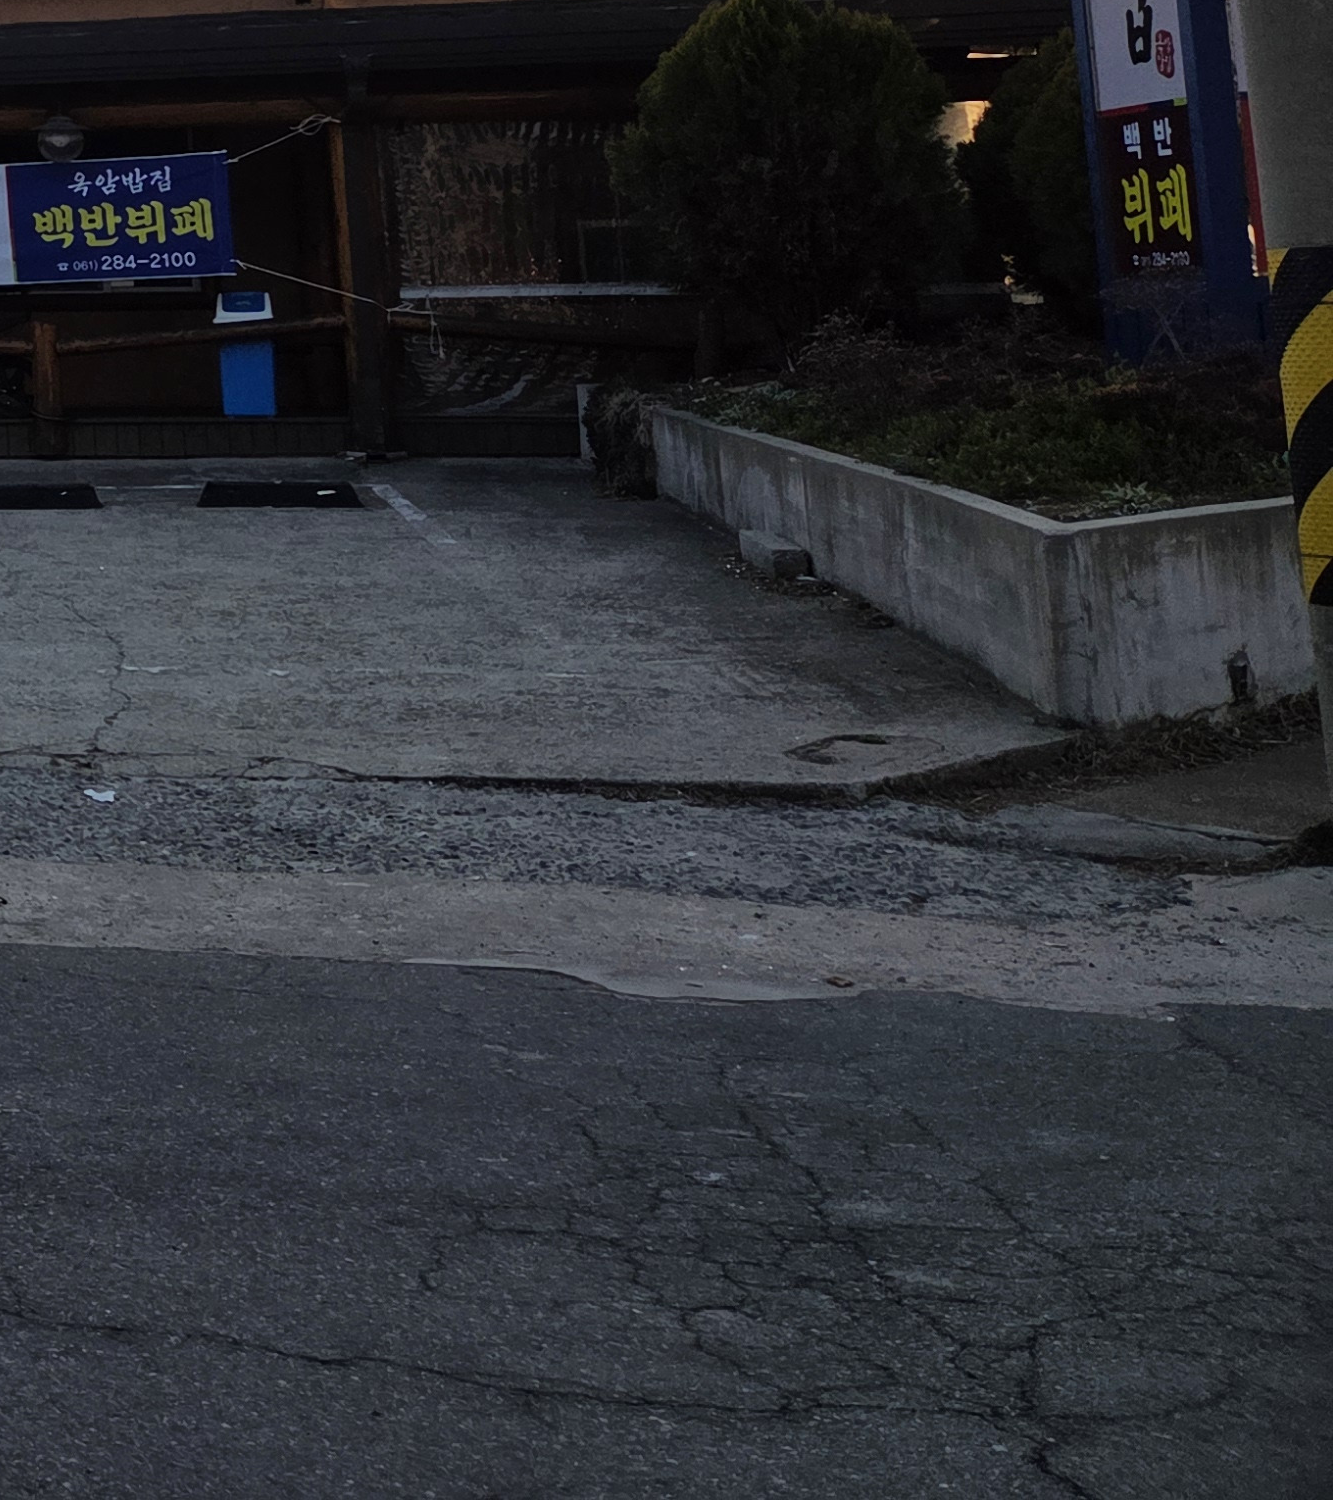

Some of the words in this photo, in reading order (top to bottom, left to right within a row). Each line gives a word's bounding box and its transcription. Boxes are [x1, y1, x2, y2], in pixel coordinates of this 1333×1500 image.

[67, 166, 171, 197] 옥암밥집
[1121, 163, 1192, 245] 뷔페
[33, 198, 215, 249] 백반뷔페
